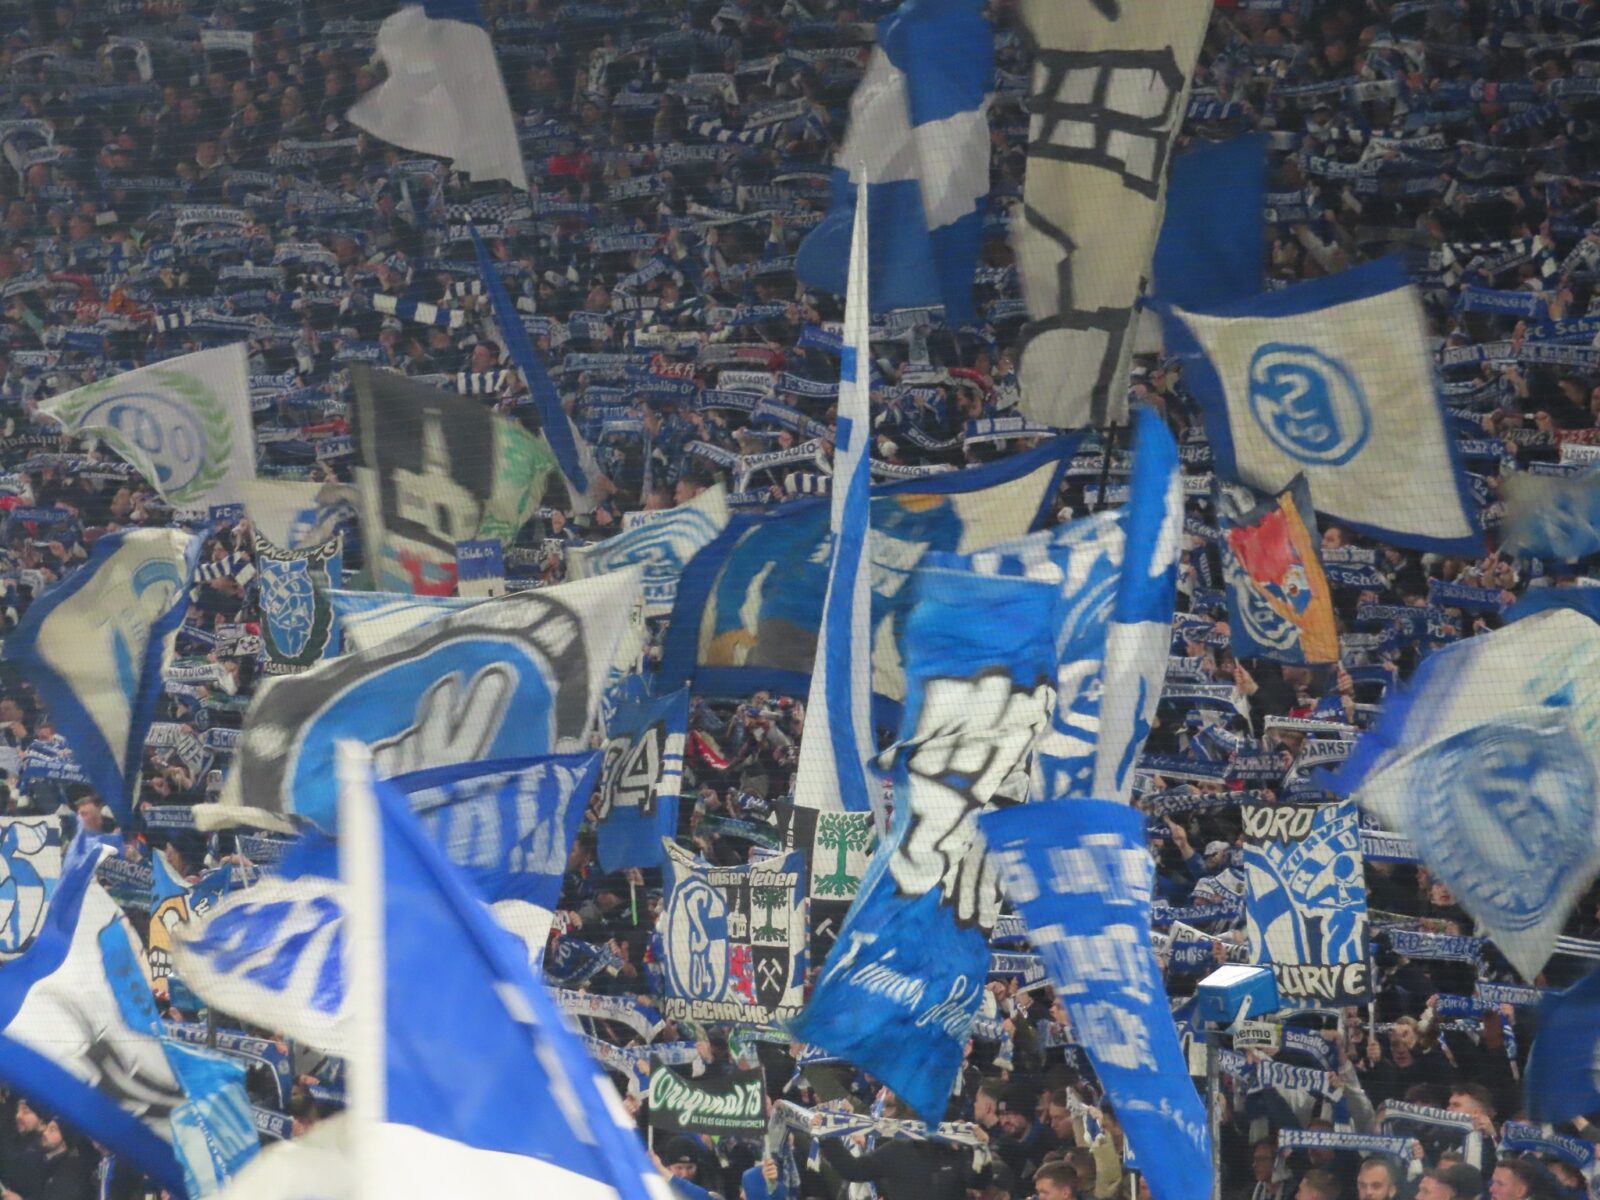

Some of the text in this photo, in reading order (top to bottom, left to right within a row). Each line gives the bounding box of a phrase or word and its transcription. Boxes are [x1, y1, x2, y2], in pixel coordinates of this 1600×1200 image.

[1525, 326, 1545, 341] FC
[633, 380, 678, 394] Schalke
[750, 868, 799, 887] leben
[665, 998, 687, 1020] FC
[1286, 1030, 1330, 1054] Schalke
[649, 1065, 744, 1127] Original
[1507, 1124, 1592, 1161] Gelseirchen
